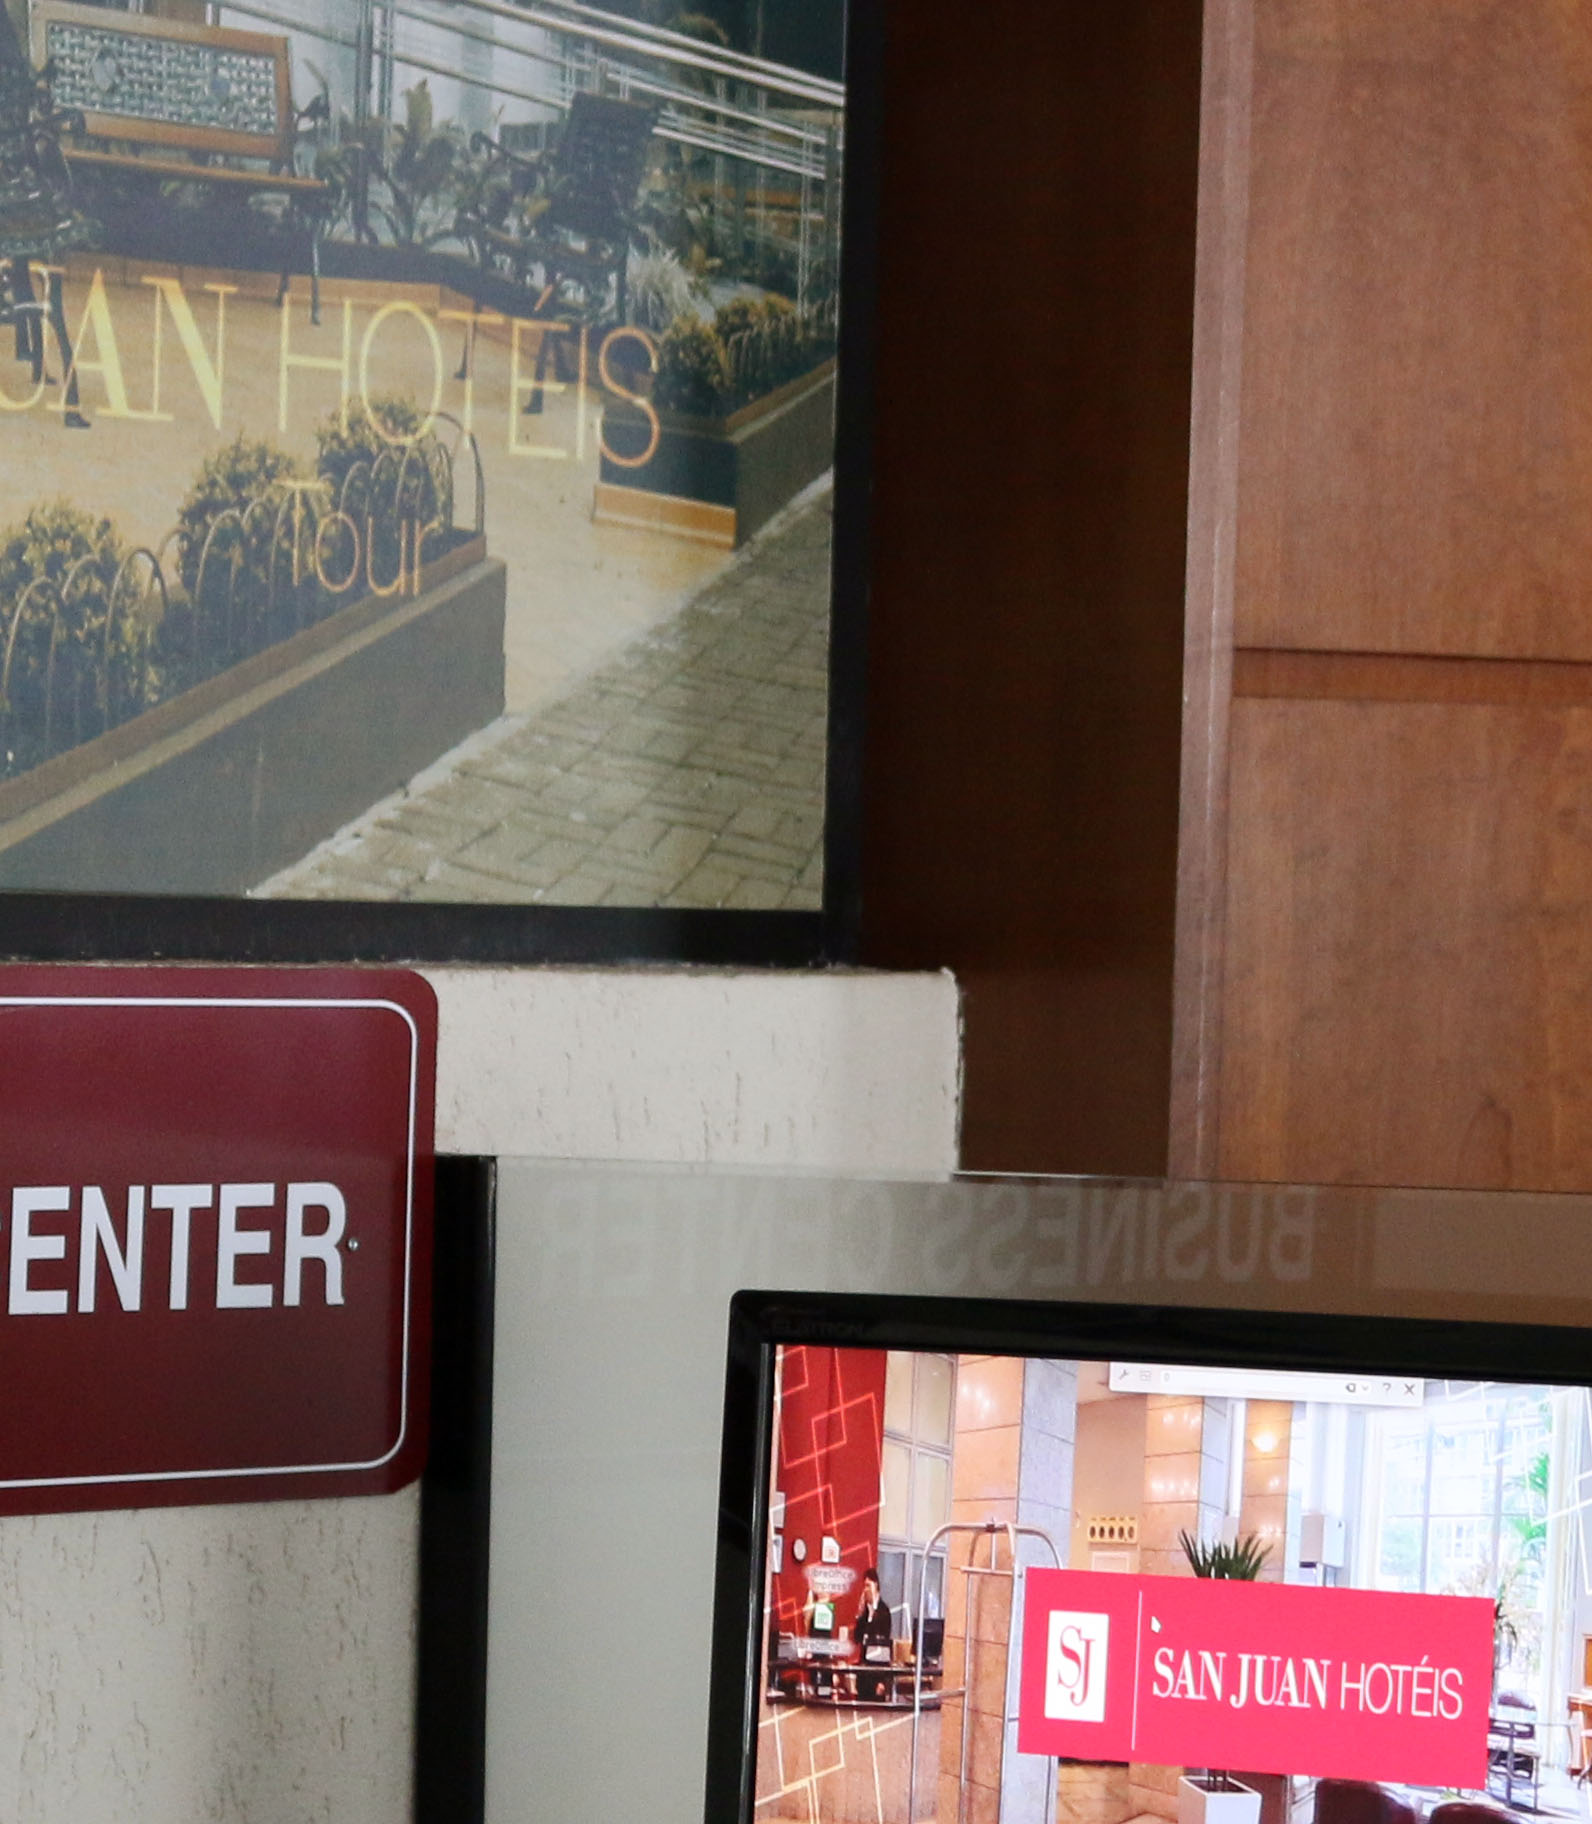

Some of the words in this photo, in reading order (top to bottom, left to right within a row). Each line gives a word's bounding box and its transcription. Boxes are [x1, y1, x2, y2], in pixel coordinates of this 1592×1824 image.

[280, 283, 661, 467] HOTÉIS
[282, 480, 444, 597] Tour
[1057, 1625, 1096, 1706] SJ
[1152, 1647, 1227, 1701] SAN
[1229, 1653, 1331, 1710] JUAN
[1340, 1655, 1463, 1721] HOTÉIS
